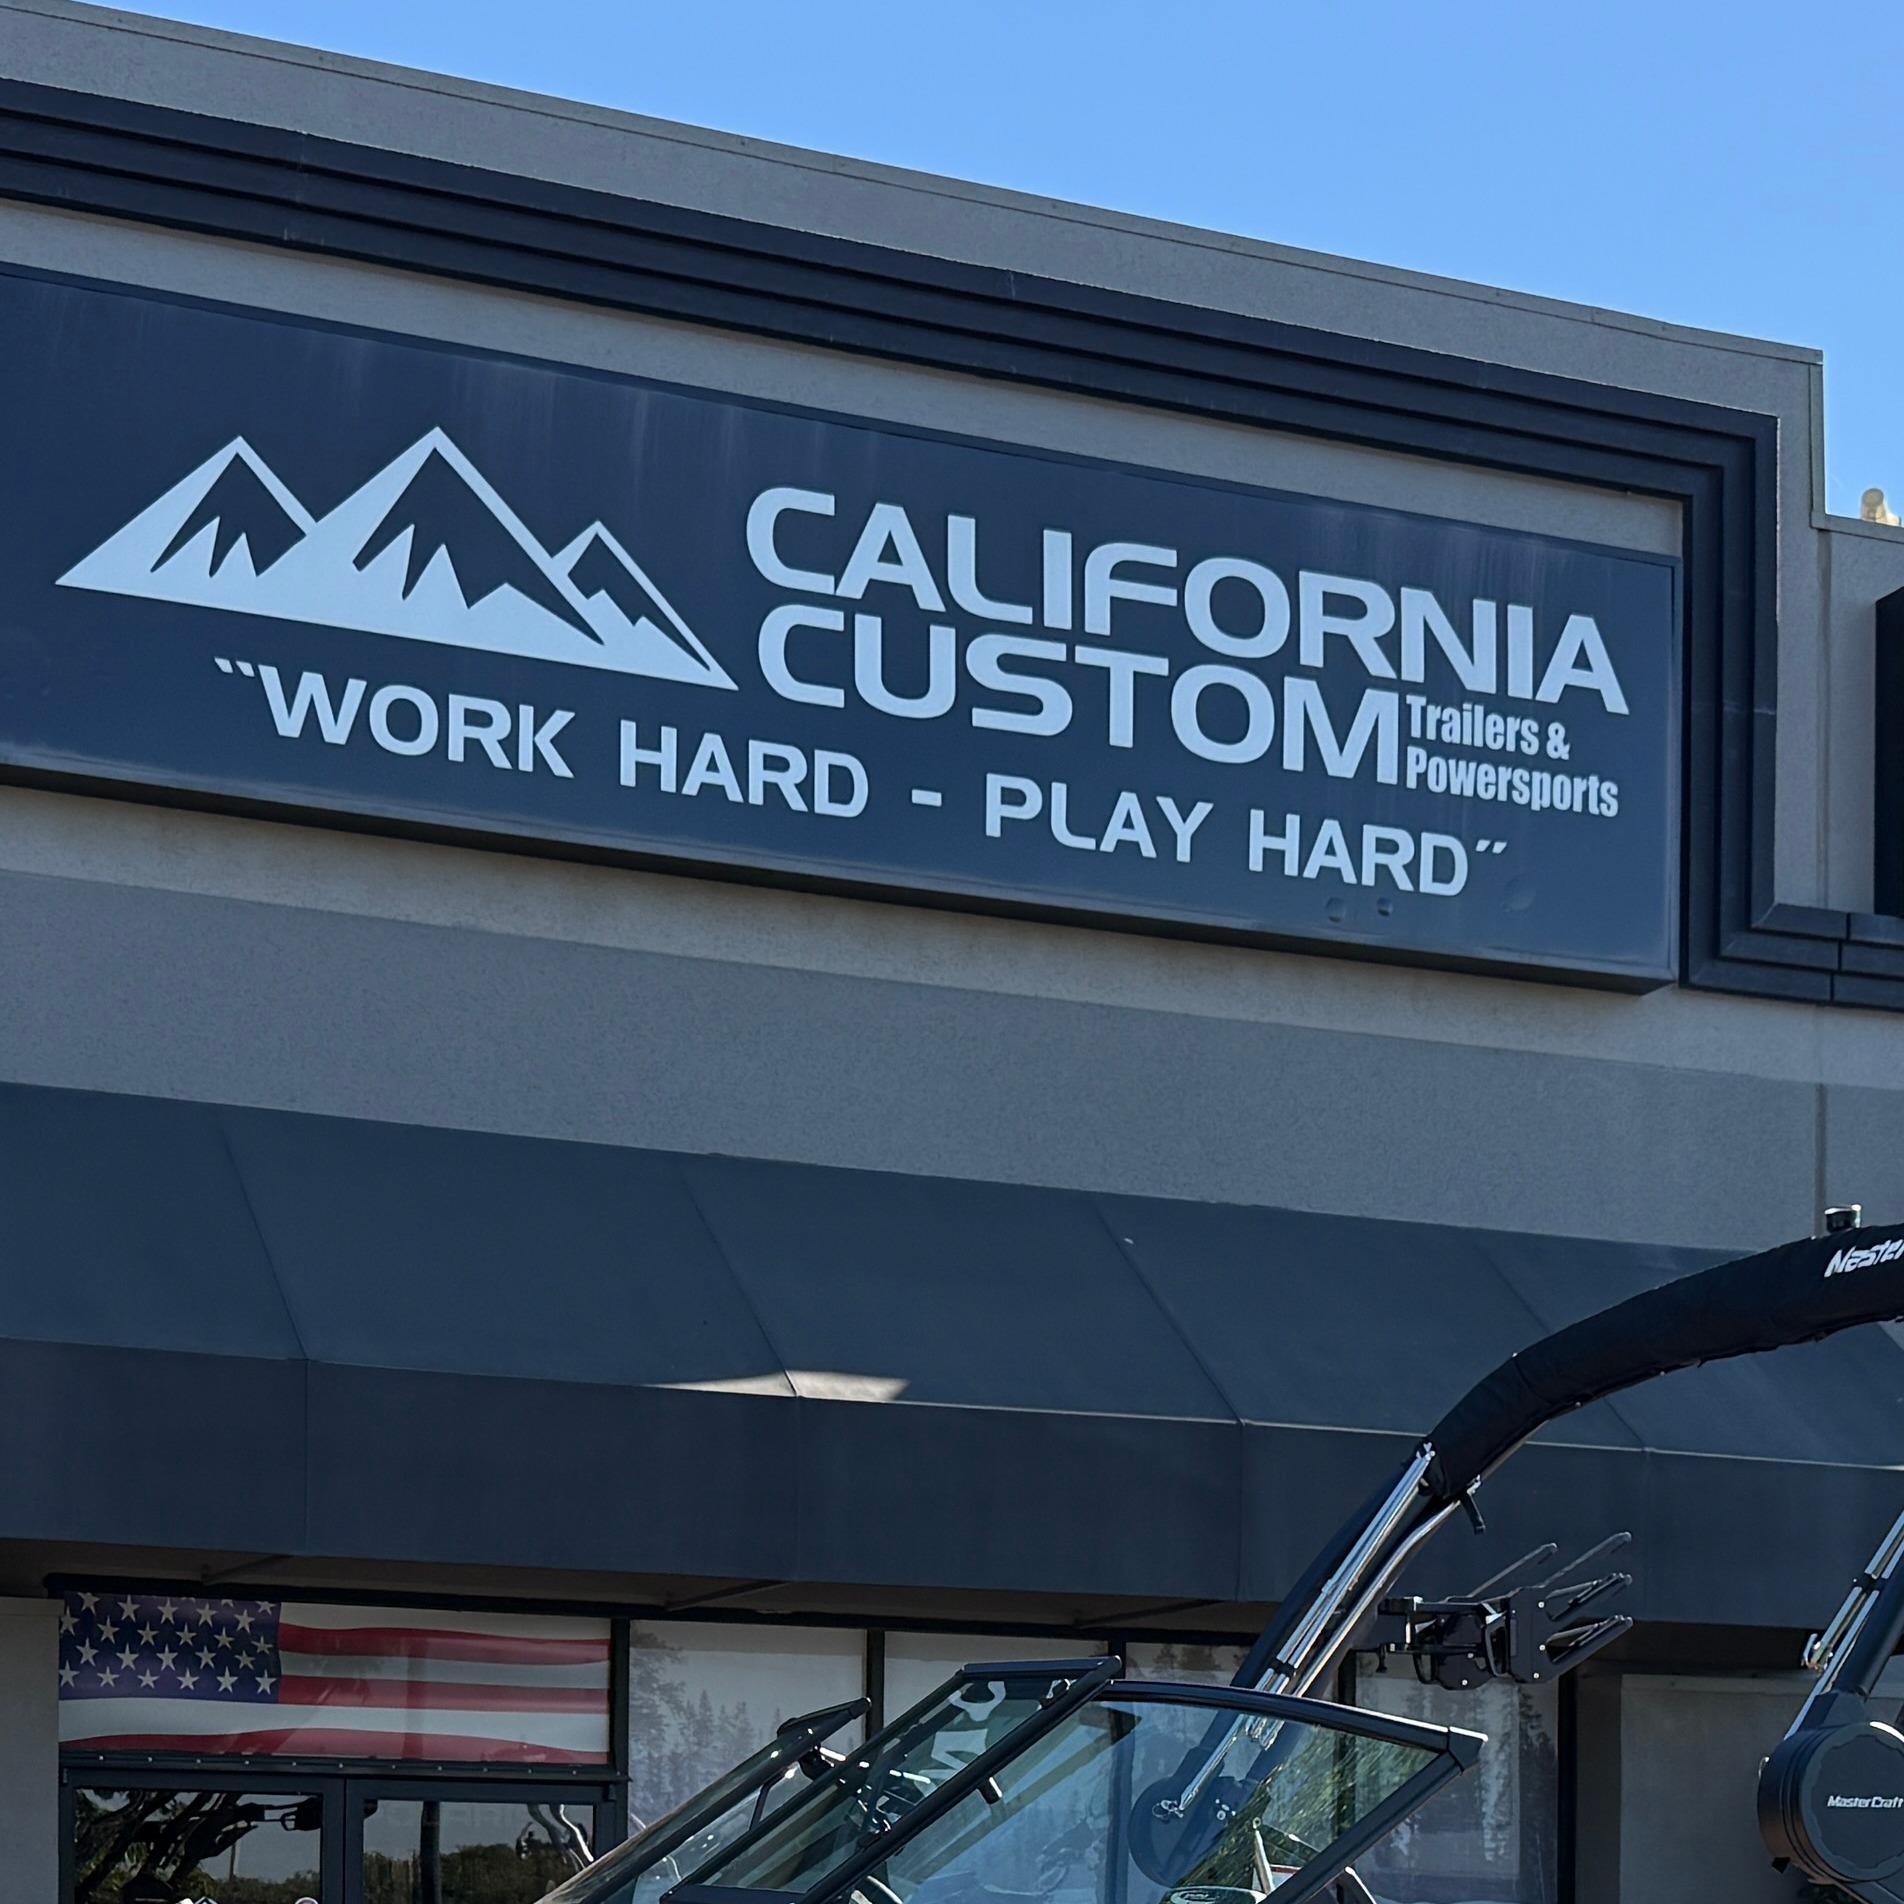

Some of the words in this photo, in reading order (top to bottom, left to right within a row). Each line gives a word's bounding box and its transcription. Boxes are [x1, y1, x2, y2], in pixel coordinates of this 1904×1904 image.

[746, 487, 1628, 715] CALIFORNIA
[757, 604, 1398, 786] CUSTOM
[1406, 694, 1539, 756] Trailers
[1546, 721, 1570, 761] &
[619, 720, 870, 821] HARD
[985, 775, 1213, 864] PLAY
[1406, 745, 1619, 818] Powersports
[1827, 1795, 1904, 1809] MasterCraft
